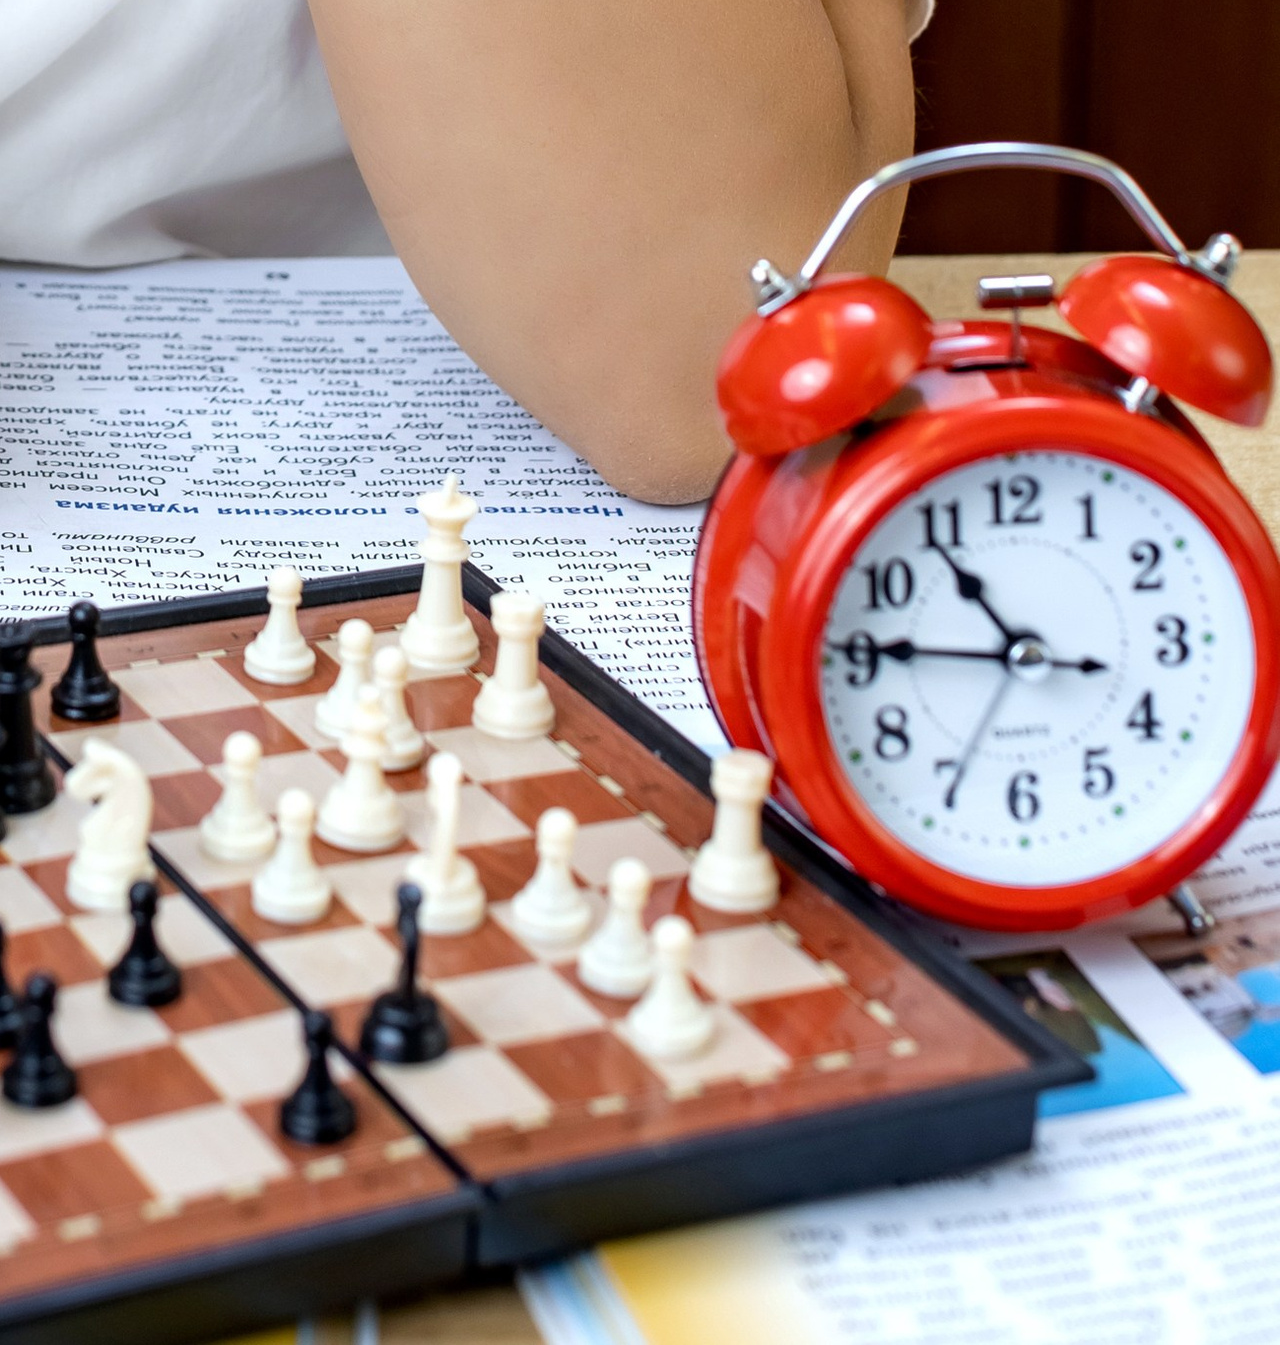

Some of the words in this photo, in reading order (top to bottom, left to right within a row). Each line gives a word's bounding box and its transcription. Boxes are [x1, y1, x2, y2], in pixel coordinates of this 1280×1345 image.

[77, 374, 238, 382] осуществляет
[260, 377, 298, 385] кто
[134, 385, 245, 393] иудаизме
[308, 389, 389, 397] правил
[324, 399, 480, 408] принадлежит
[298, 410, 382, 418] красть,
[90, 419, 188, 430] убивать,
[392, 421, 444, 429] друг
[60, 429, 192, 439] родителей,
[299, 432, 397, 441] уважать
[416, 433, 473, 441] надо
[109, 442, 168, 450] одна
[191, 444, 240, 454] Ещё
[265, 445, 422, 454] обязательно.
[446, 444, 556, 452] заповеди
[28, 448, 120, 459] отдыха;
[140, 454, 196, 462] день
[278, 455, 374, 467] субботу
[394, 455, 506, 463] выделять
[37, 460, 189, 473] поклоняться
[380, 467, 466, 475] одного
[299, 469, 357, 478] Бога
[118, 475, 166, 485] Они
[186, 479, 346, 490] единобожия.
[484, 477, 606, 486] ерждался
[50, 483, 159, 497] Моисеем
[181, 489, 328, 499] полученных
[350, 490, 484, 499] заедях,
[507, 489, 562, 499] трёх
[986, 474, 1043, 526] 12
[55, 500, 199, 514] иудаизма
[218, 507, 387, 516] положения
[404, 505, 624, 517] Нравствее
[1077, 493, 1101, 541] 1
[917, 500, 963, 549] 11
[52, 532, 196, 544] раввинами,
[220, 539, 340, 548] называли
[62, 544, 205, 558] Священное
[233, 549, 322, 559] народу
[512, 549, 618, 558] которые
[70, 556, 152, 568] Новый
[217, 562, 360, 572] назыться
[1129, 540, 1163, 591] 2
[30, 565, 127, 579] Христа,
[558, 562, 652, 573] Библии
[150, 570, 240, 583] Иисуса
[548, 575, 604, 583] него
[863, 557, 914, 610] 10
[23, 590, 94, 598] стали
[1155, 614, 1189, 667] 3
[845, 631, 880, 687] 9
[1126, 690, 1162, 741] 4
[874, 705, 911, 759] 8
[1083, 747, 1114, 797] 5
[935, 759, 968, 810] 7
[1006, 772, 1041, 822] 6
